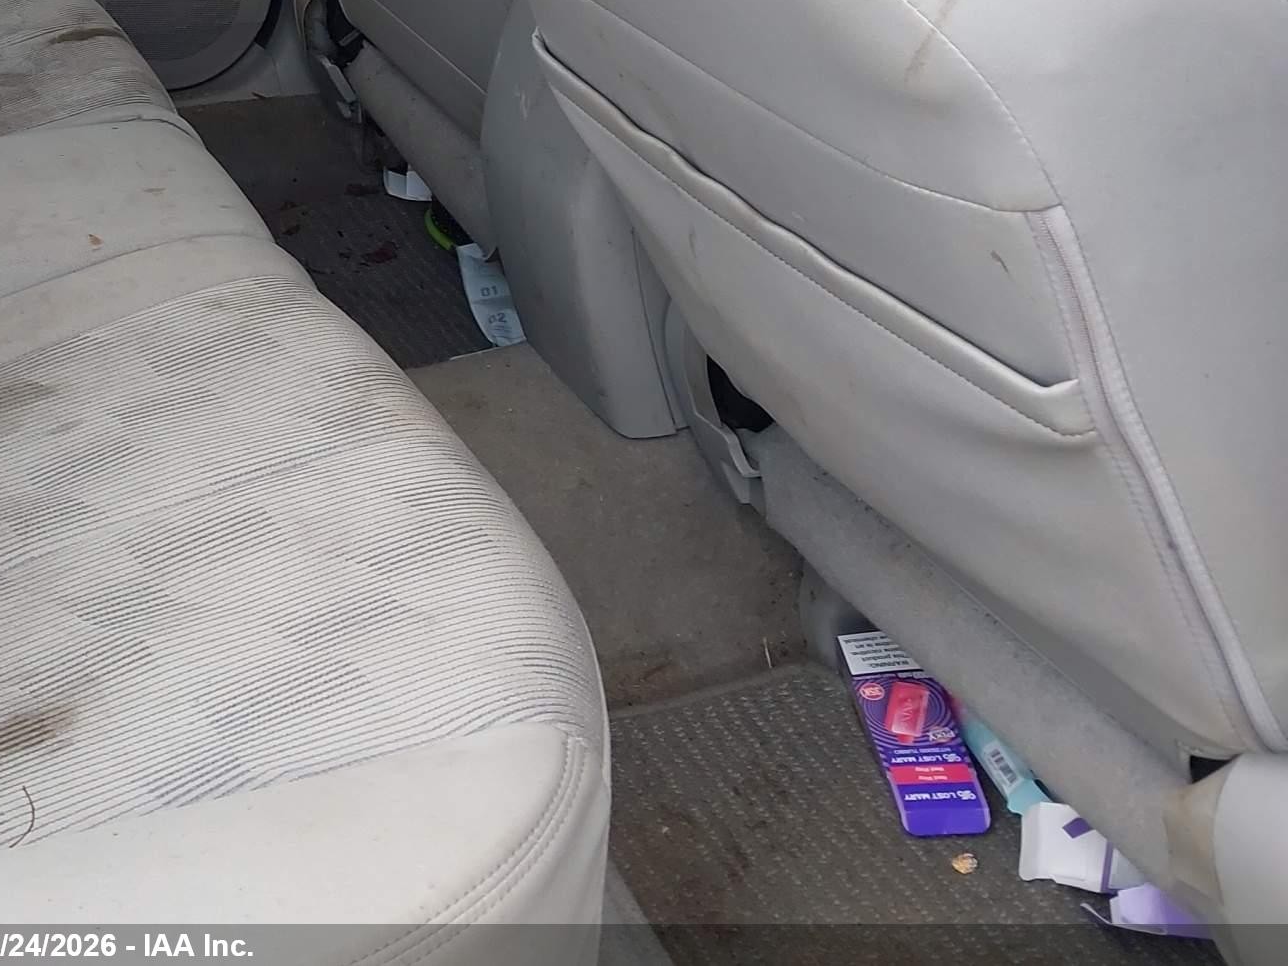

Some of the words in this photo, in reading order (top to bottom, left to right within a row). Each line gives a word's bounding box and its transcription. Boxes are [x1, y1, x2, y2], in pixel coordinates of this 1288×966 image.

[891, 756, 917, 764] MARY
[918, 755, 943, 763] LOST
[904, 792, 931, 801] MARY
[931, 792, 957, 801] LOST
